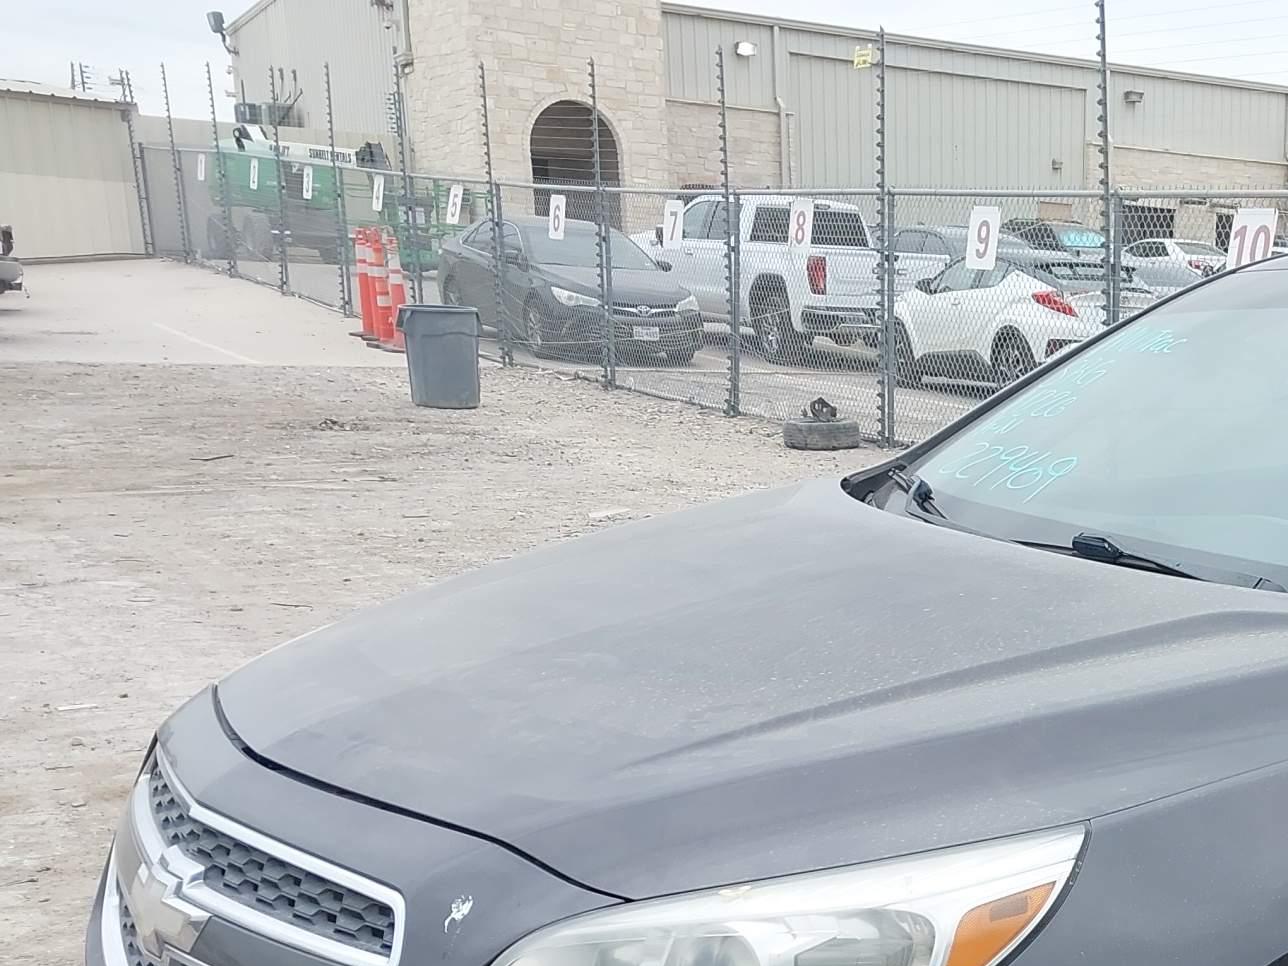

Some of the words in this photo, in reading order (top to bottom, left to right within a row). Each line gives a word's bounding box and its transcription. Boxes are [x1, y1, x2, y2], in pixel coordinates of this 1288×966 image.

[305, 172, 310, 193] 3
[375, 183, 381, 205] 4
[450, 193, 459, 218] 5
[553, 203, 561, 233] 6
[669, 210, 678, 241] 7
[793, 210, 806, 245] 8
[975, 219, 991, 260] 9
[1232, 224, 1272, 268] 10
